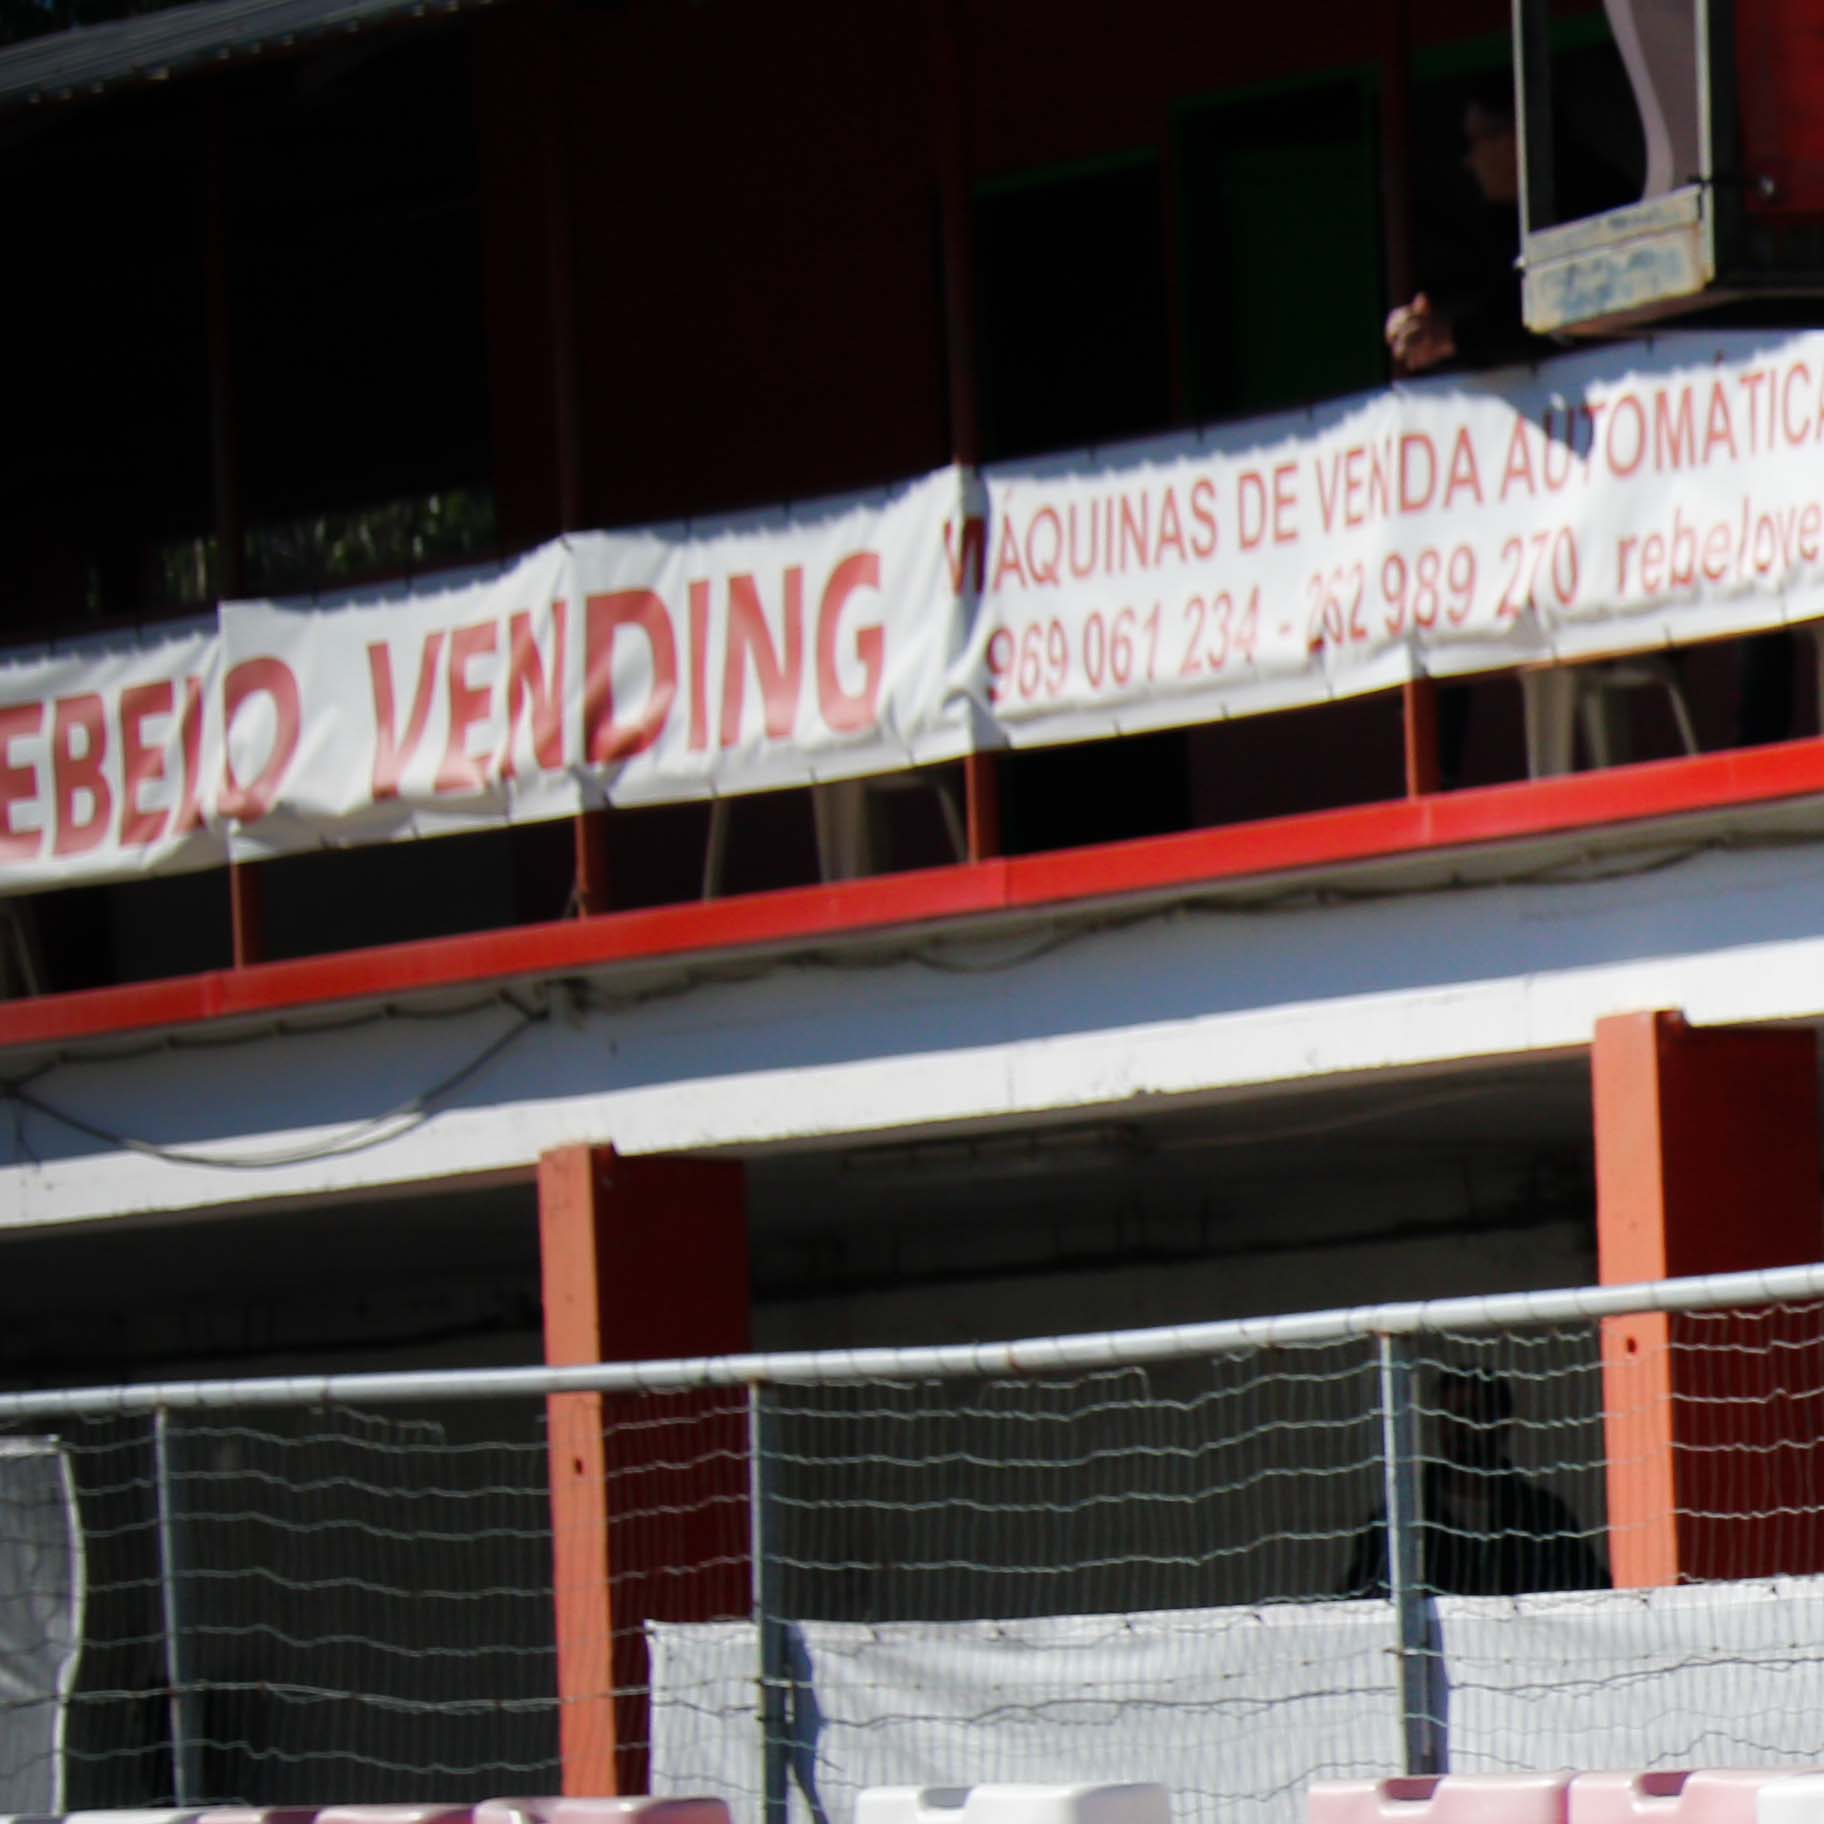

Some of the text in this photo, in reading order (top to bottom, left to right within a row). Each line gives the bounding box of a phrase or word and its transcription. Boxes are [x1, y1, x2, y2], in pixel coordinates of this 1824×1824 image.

[1237, 460, 1300, 552] DE
[1315, 424, 1484, 533] VENDA
[366, 550, 886, 800] VENDING
[986, 618, 1070, 703] 969
[1082, 599, 1161, 690] 061
[1180, 584, 1261, 679] 234
[1380, 543, 1477, 637] 989
[1495, 523, 1580, 620] 270
